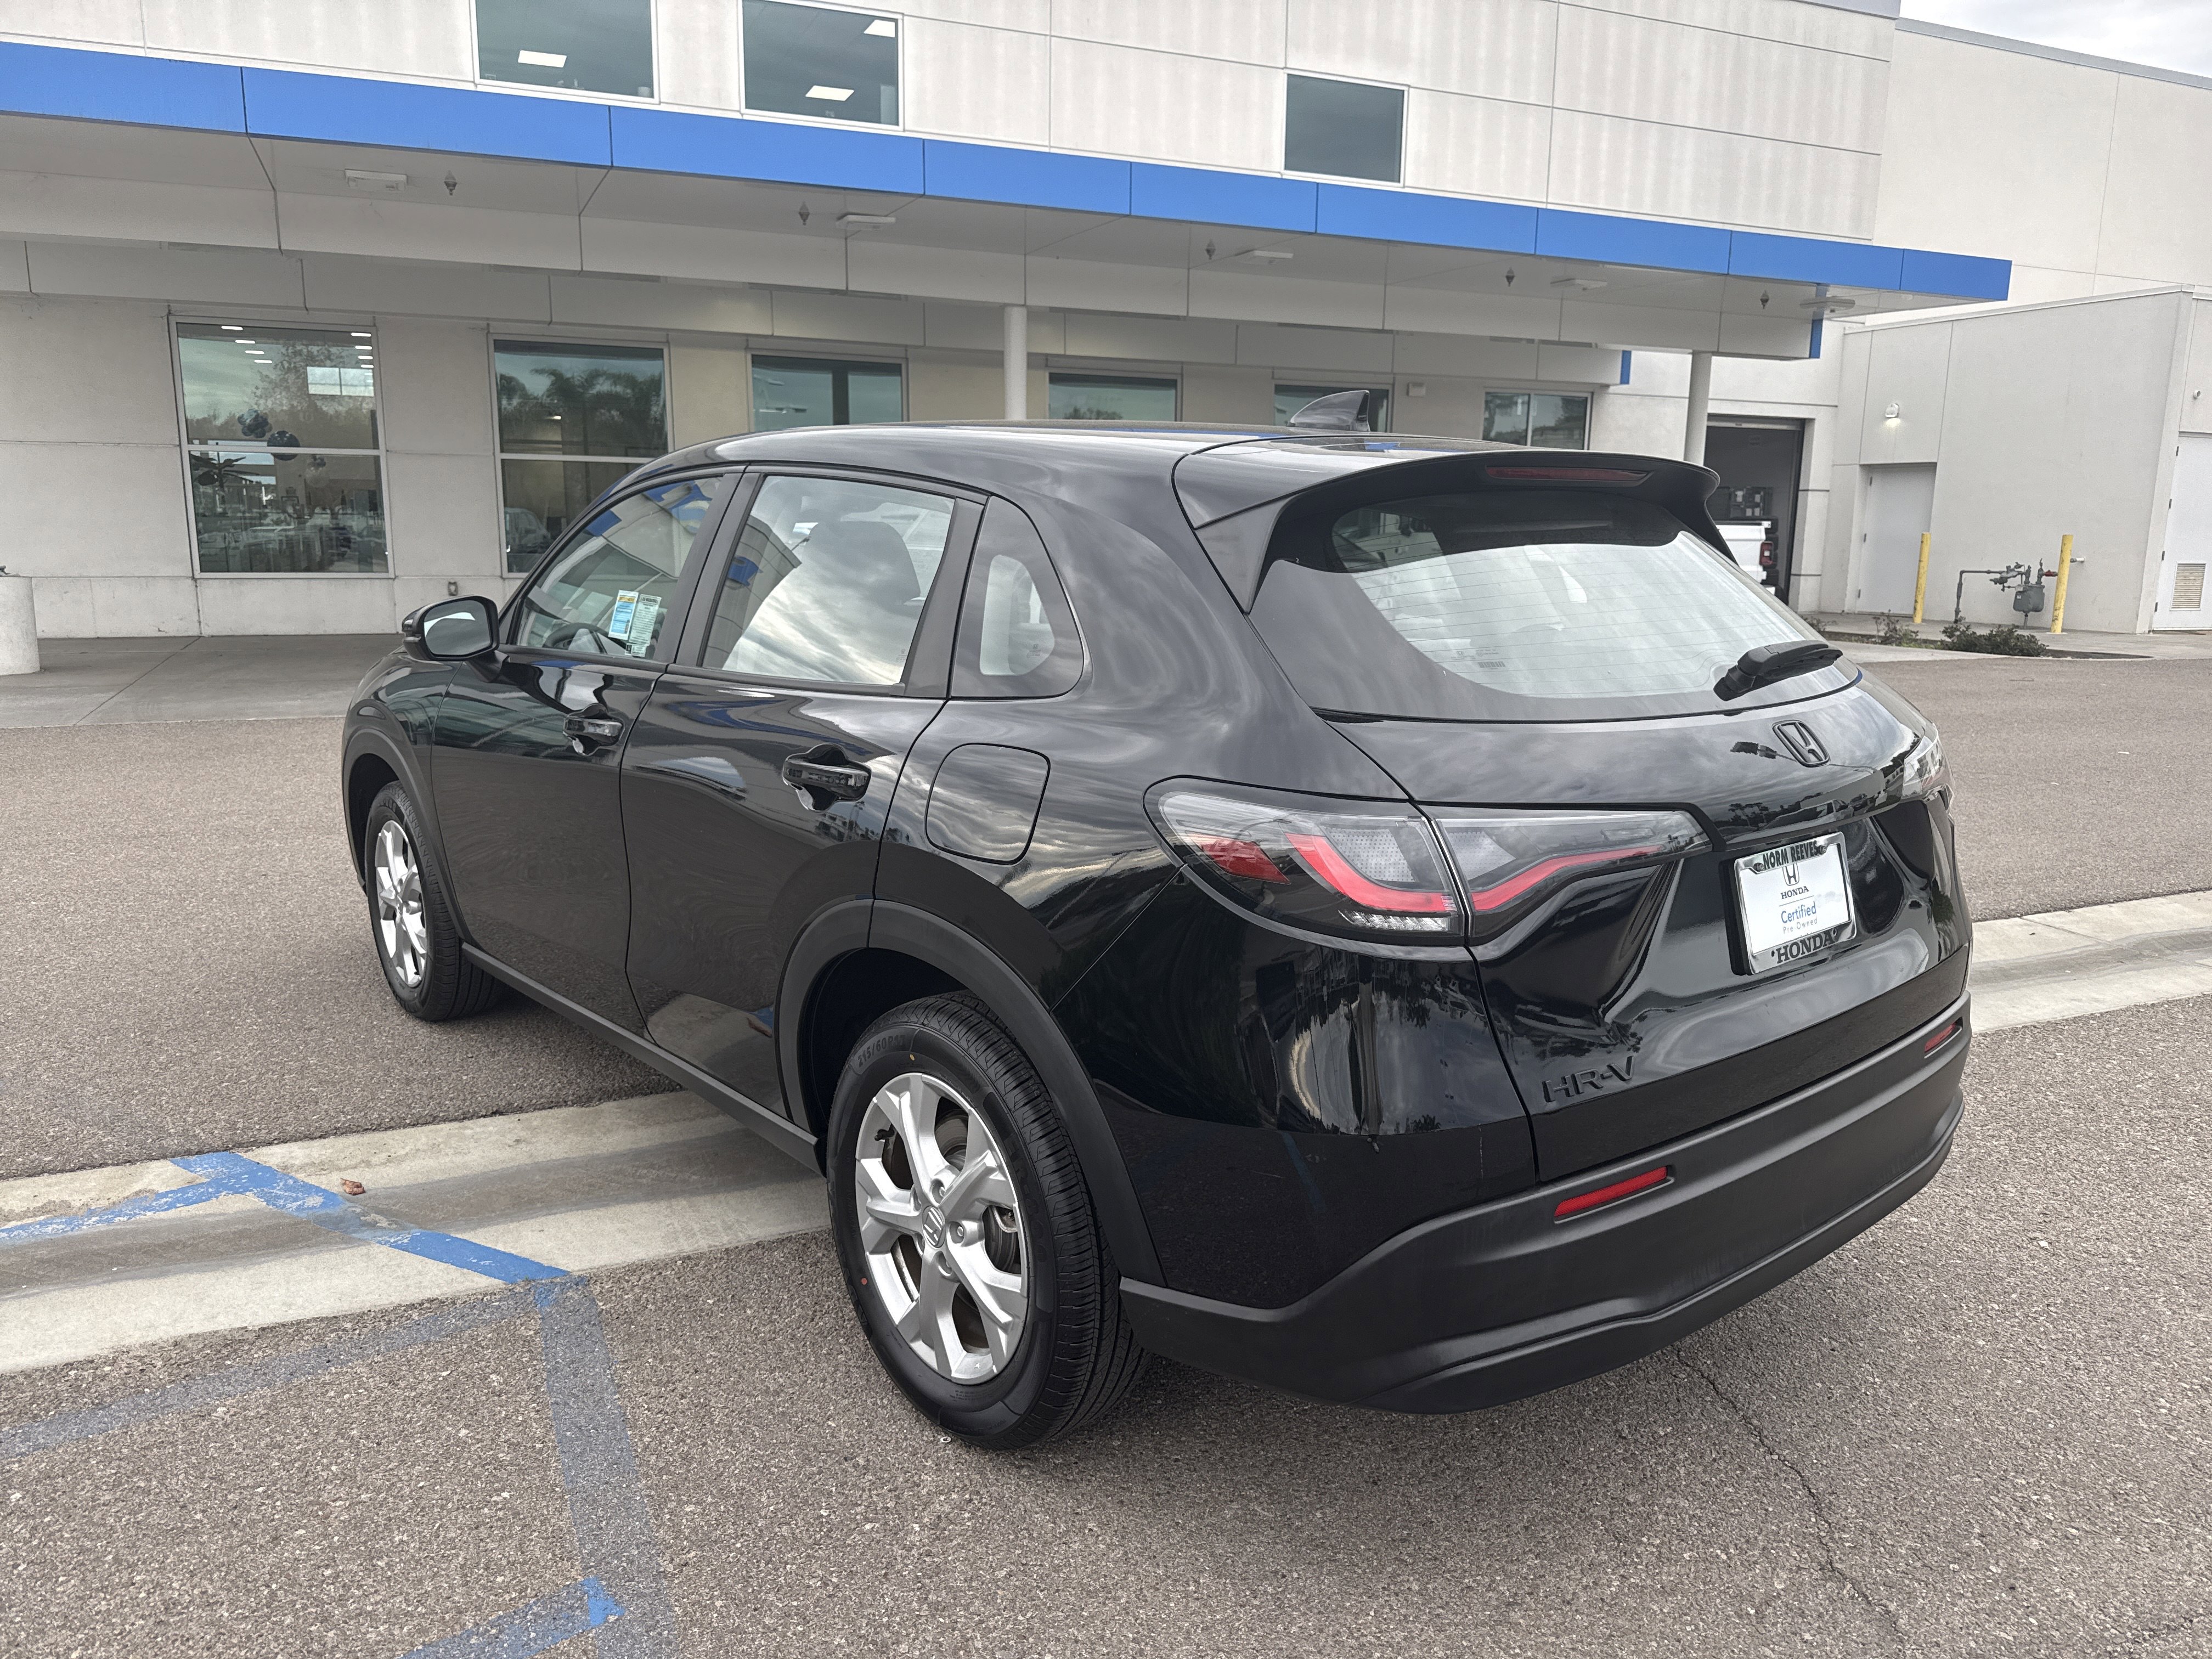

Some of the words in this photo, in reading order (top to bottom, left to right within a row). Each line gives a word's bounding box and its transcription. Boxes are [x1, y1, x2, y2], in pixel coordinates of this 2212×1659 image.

[1763, 848, 1788, 870] NORM
[1790, 840, 1818, 862] REEVES
[1781, 885, 1809, 899] HONDA
[1781, 901, 1816, 924] Certified
[1776, 931, 1835, 964] HONDA
[1542, 1055, 1634, 1103] HR-V
